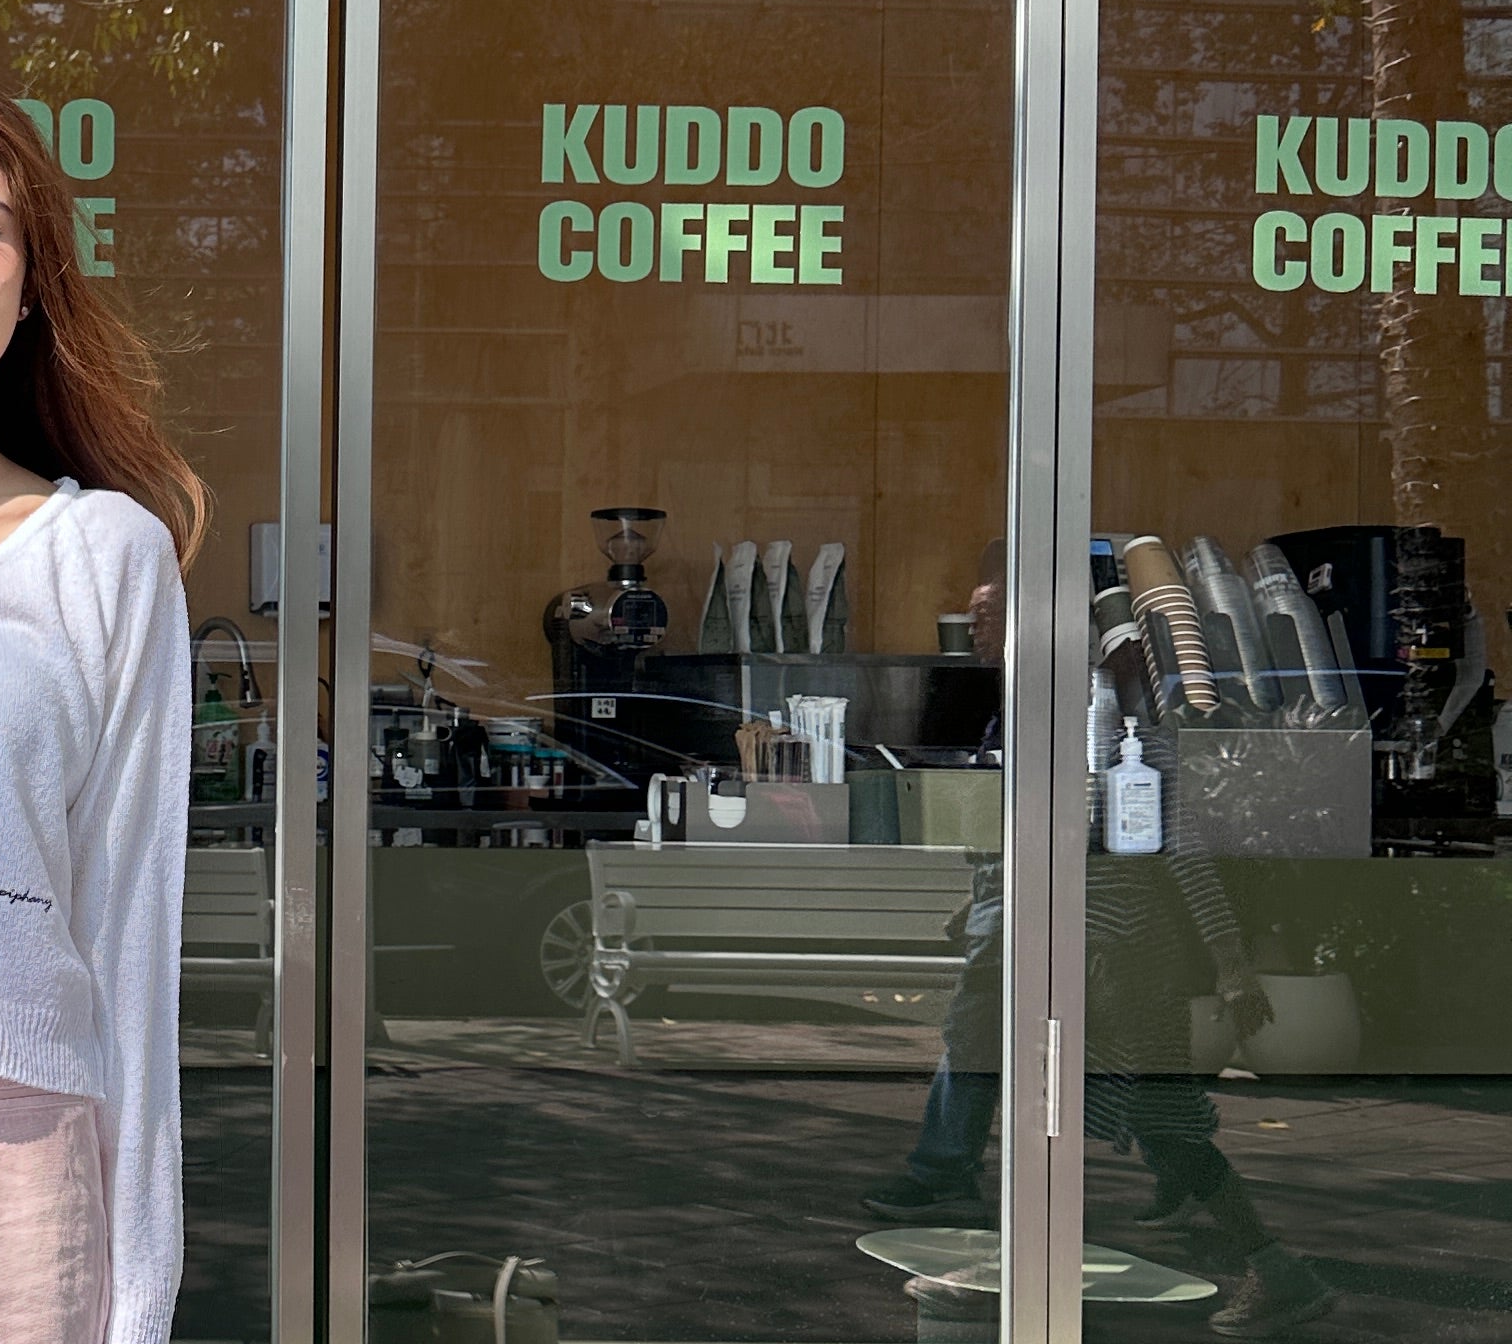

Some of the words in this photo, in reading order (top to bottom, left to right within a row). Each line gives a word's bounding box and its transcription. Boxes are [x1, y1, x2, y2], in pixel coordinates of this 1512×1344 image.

[541, 103, 845, 188] KUDDO
[538, 200, 845, 285] COFFEE
[1253, 210, 1512, 297] COFFE
